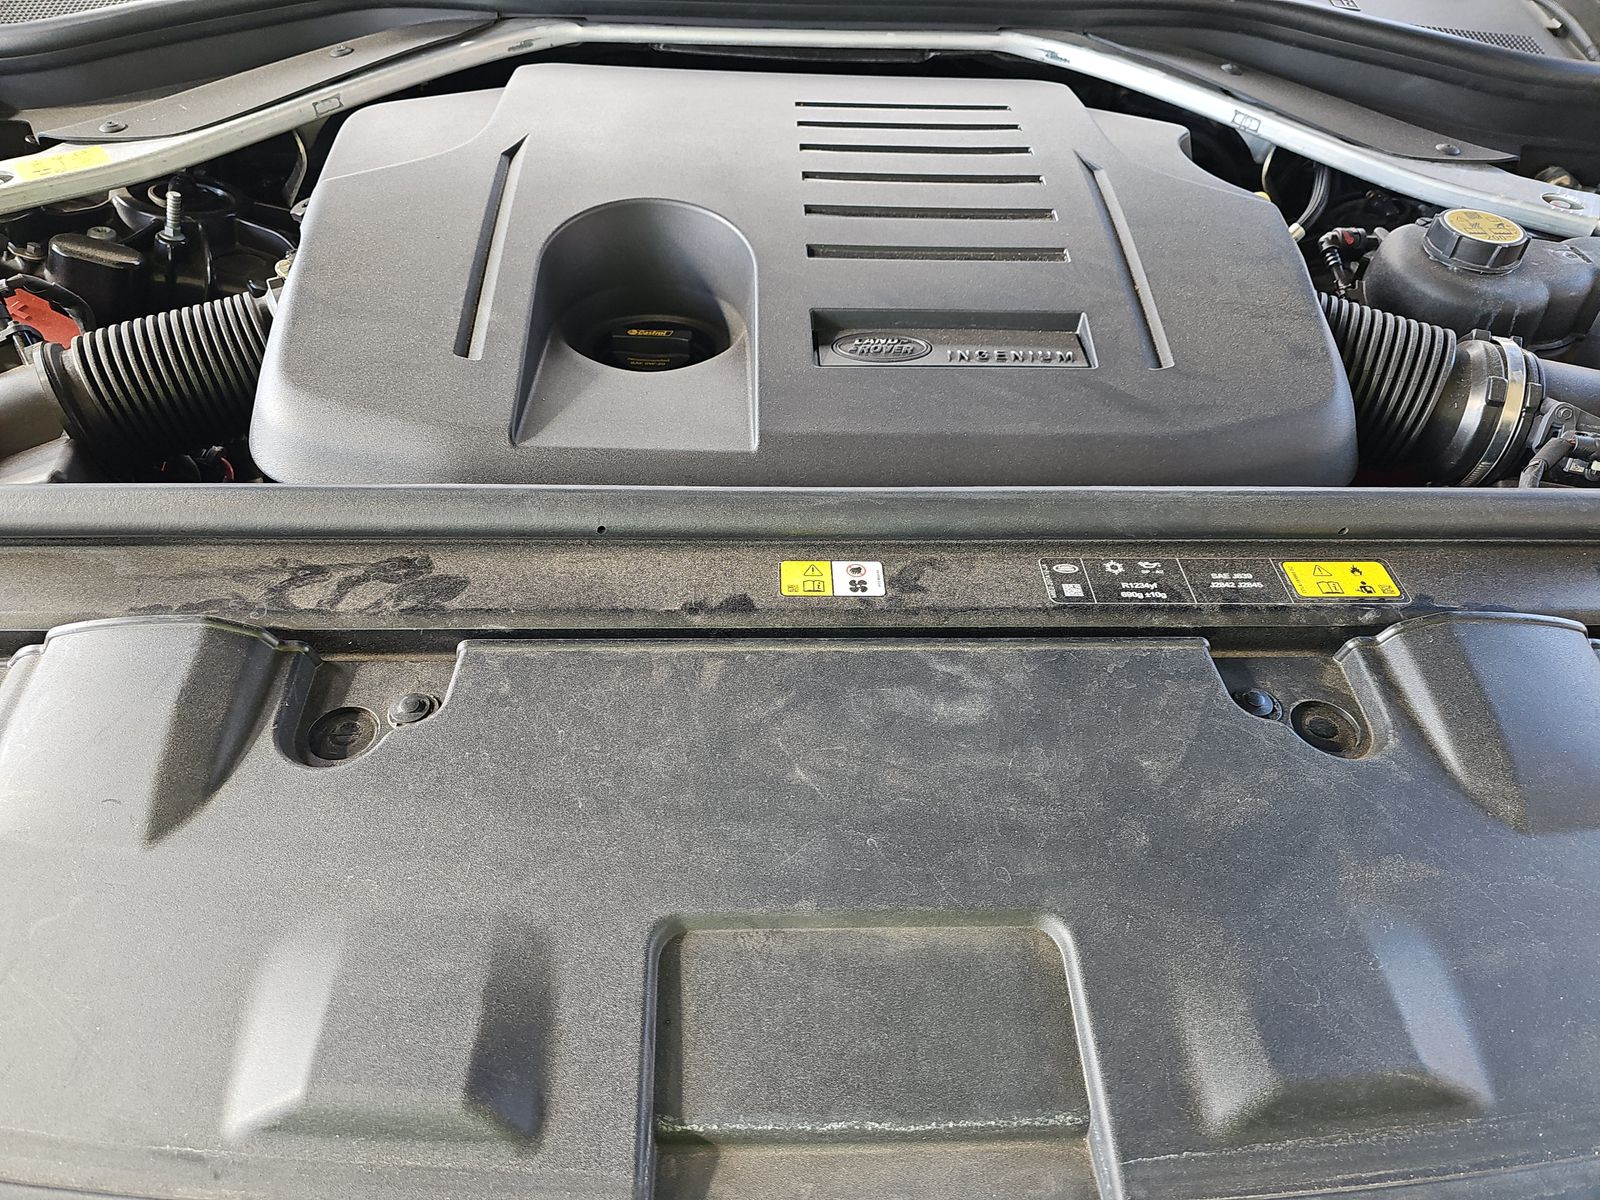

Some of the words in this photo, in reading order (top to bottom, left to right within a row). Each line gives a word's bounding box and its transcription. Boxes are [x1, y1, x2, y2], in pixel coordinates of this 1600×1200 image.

[857, 344, 915, 355] ROVER
[946, 350, 1075, 362] INGENIUM
[1120, 582, 1158, 590] R1234yf
